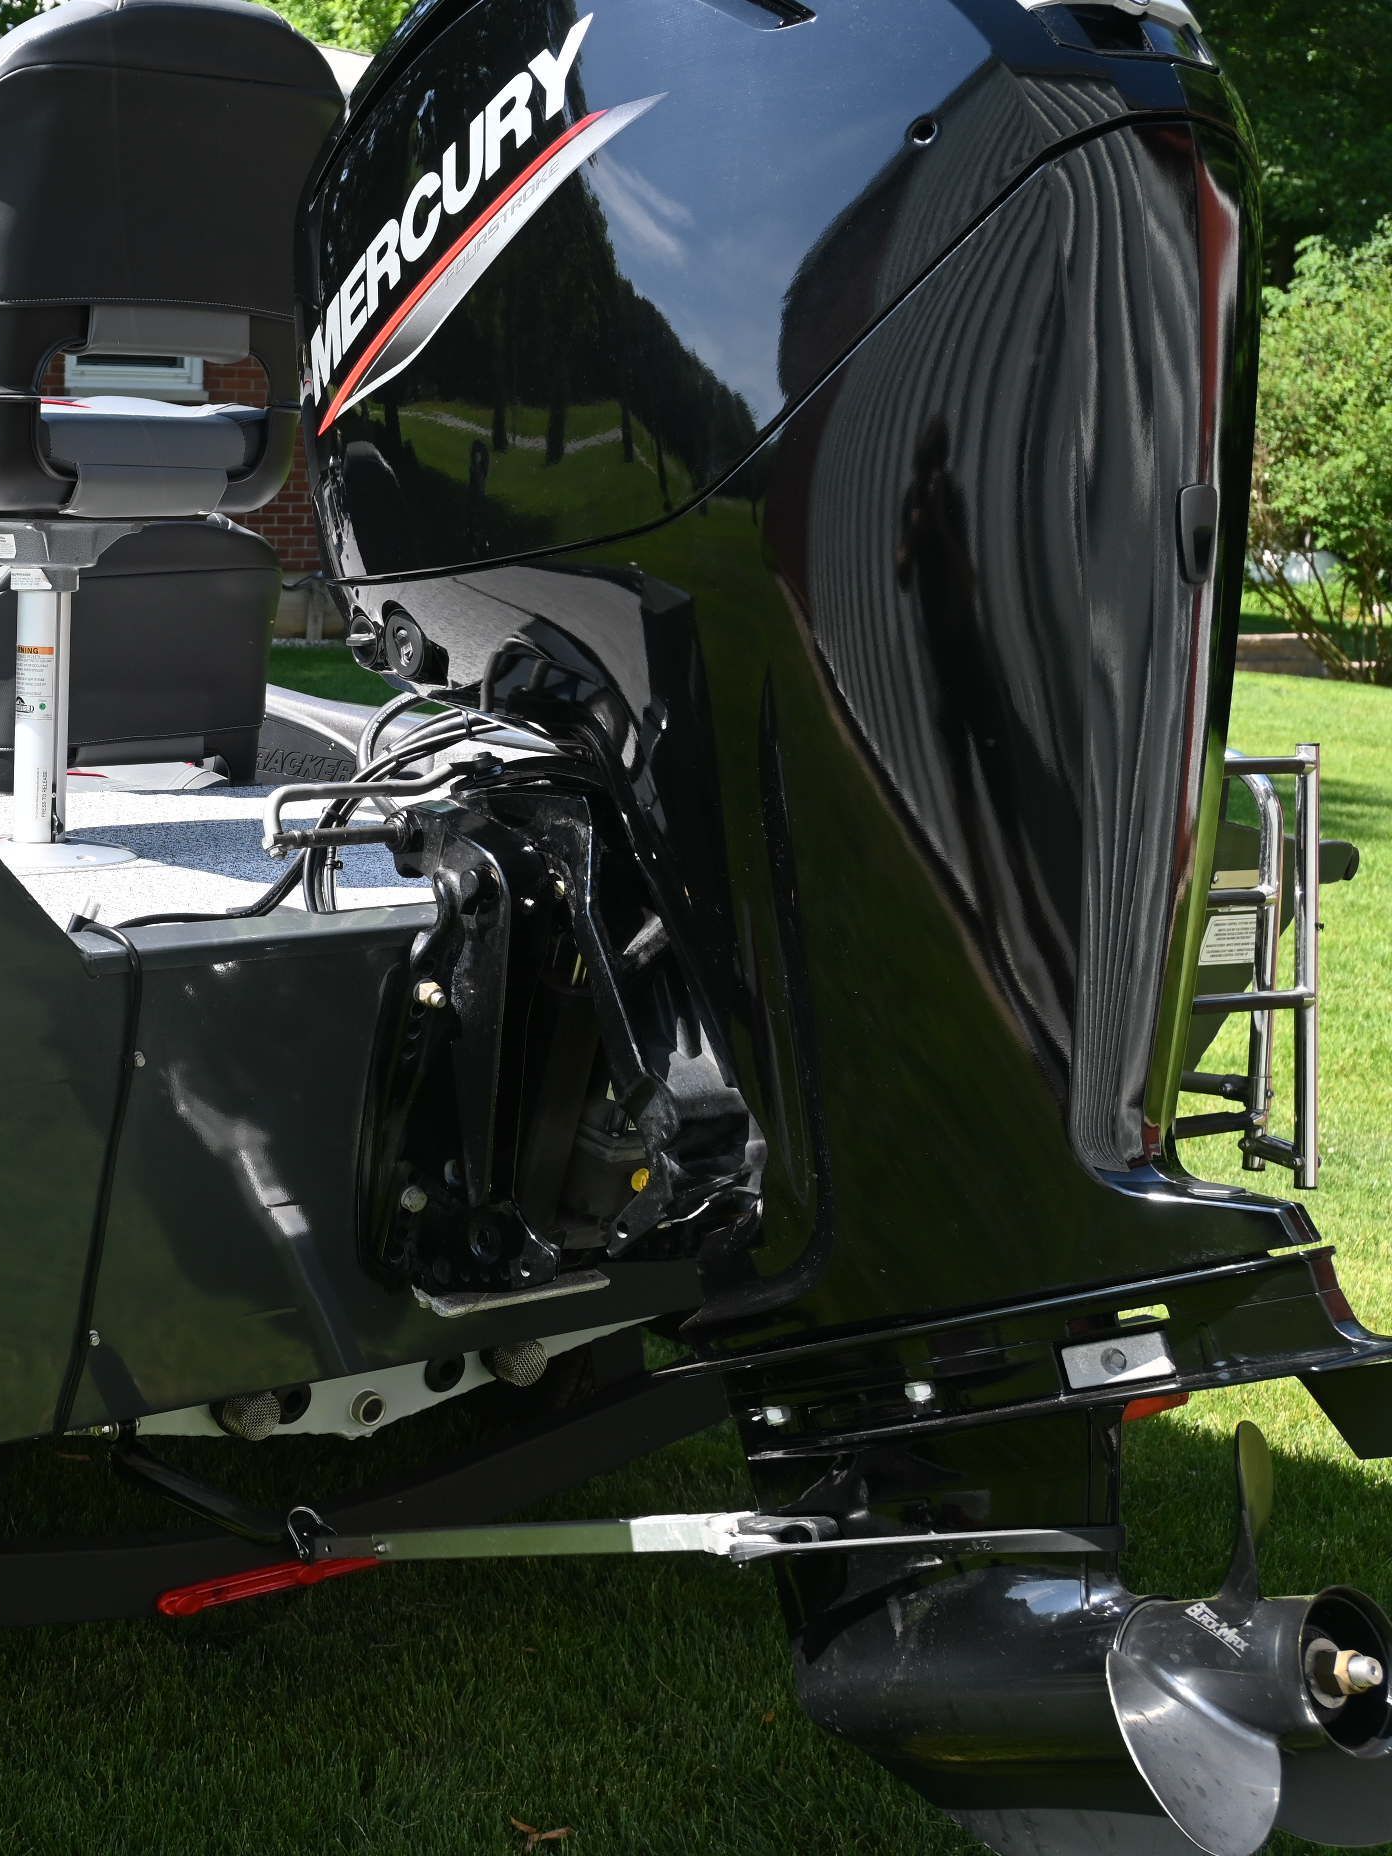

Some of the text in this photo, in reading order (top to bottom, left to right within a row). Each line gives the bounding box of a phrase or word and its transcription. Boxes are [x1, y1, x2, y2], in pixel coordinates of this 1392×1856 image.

[310, 13, 593, 406] MERCURY
[445, 159, 560, 287] FOURSTROKE
[257, 747, 357, 782] RACKER
